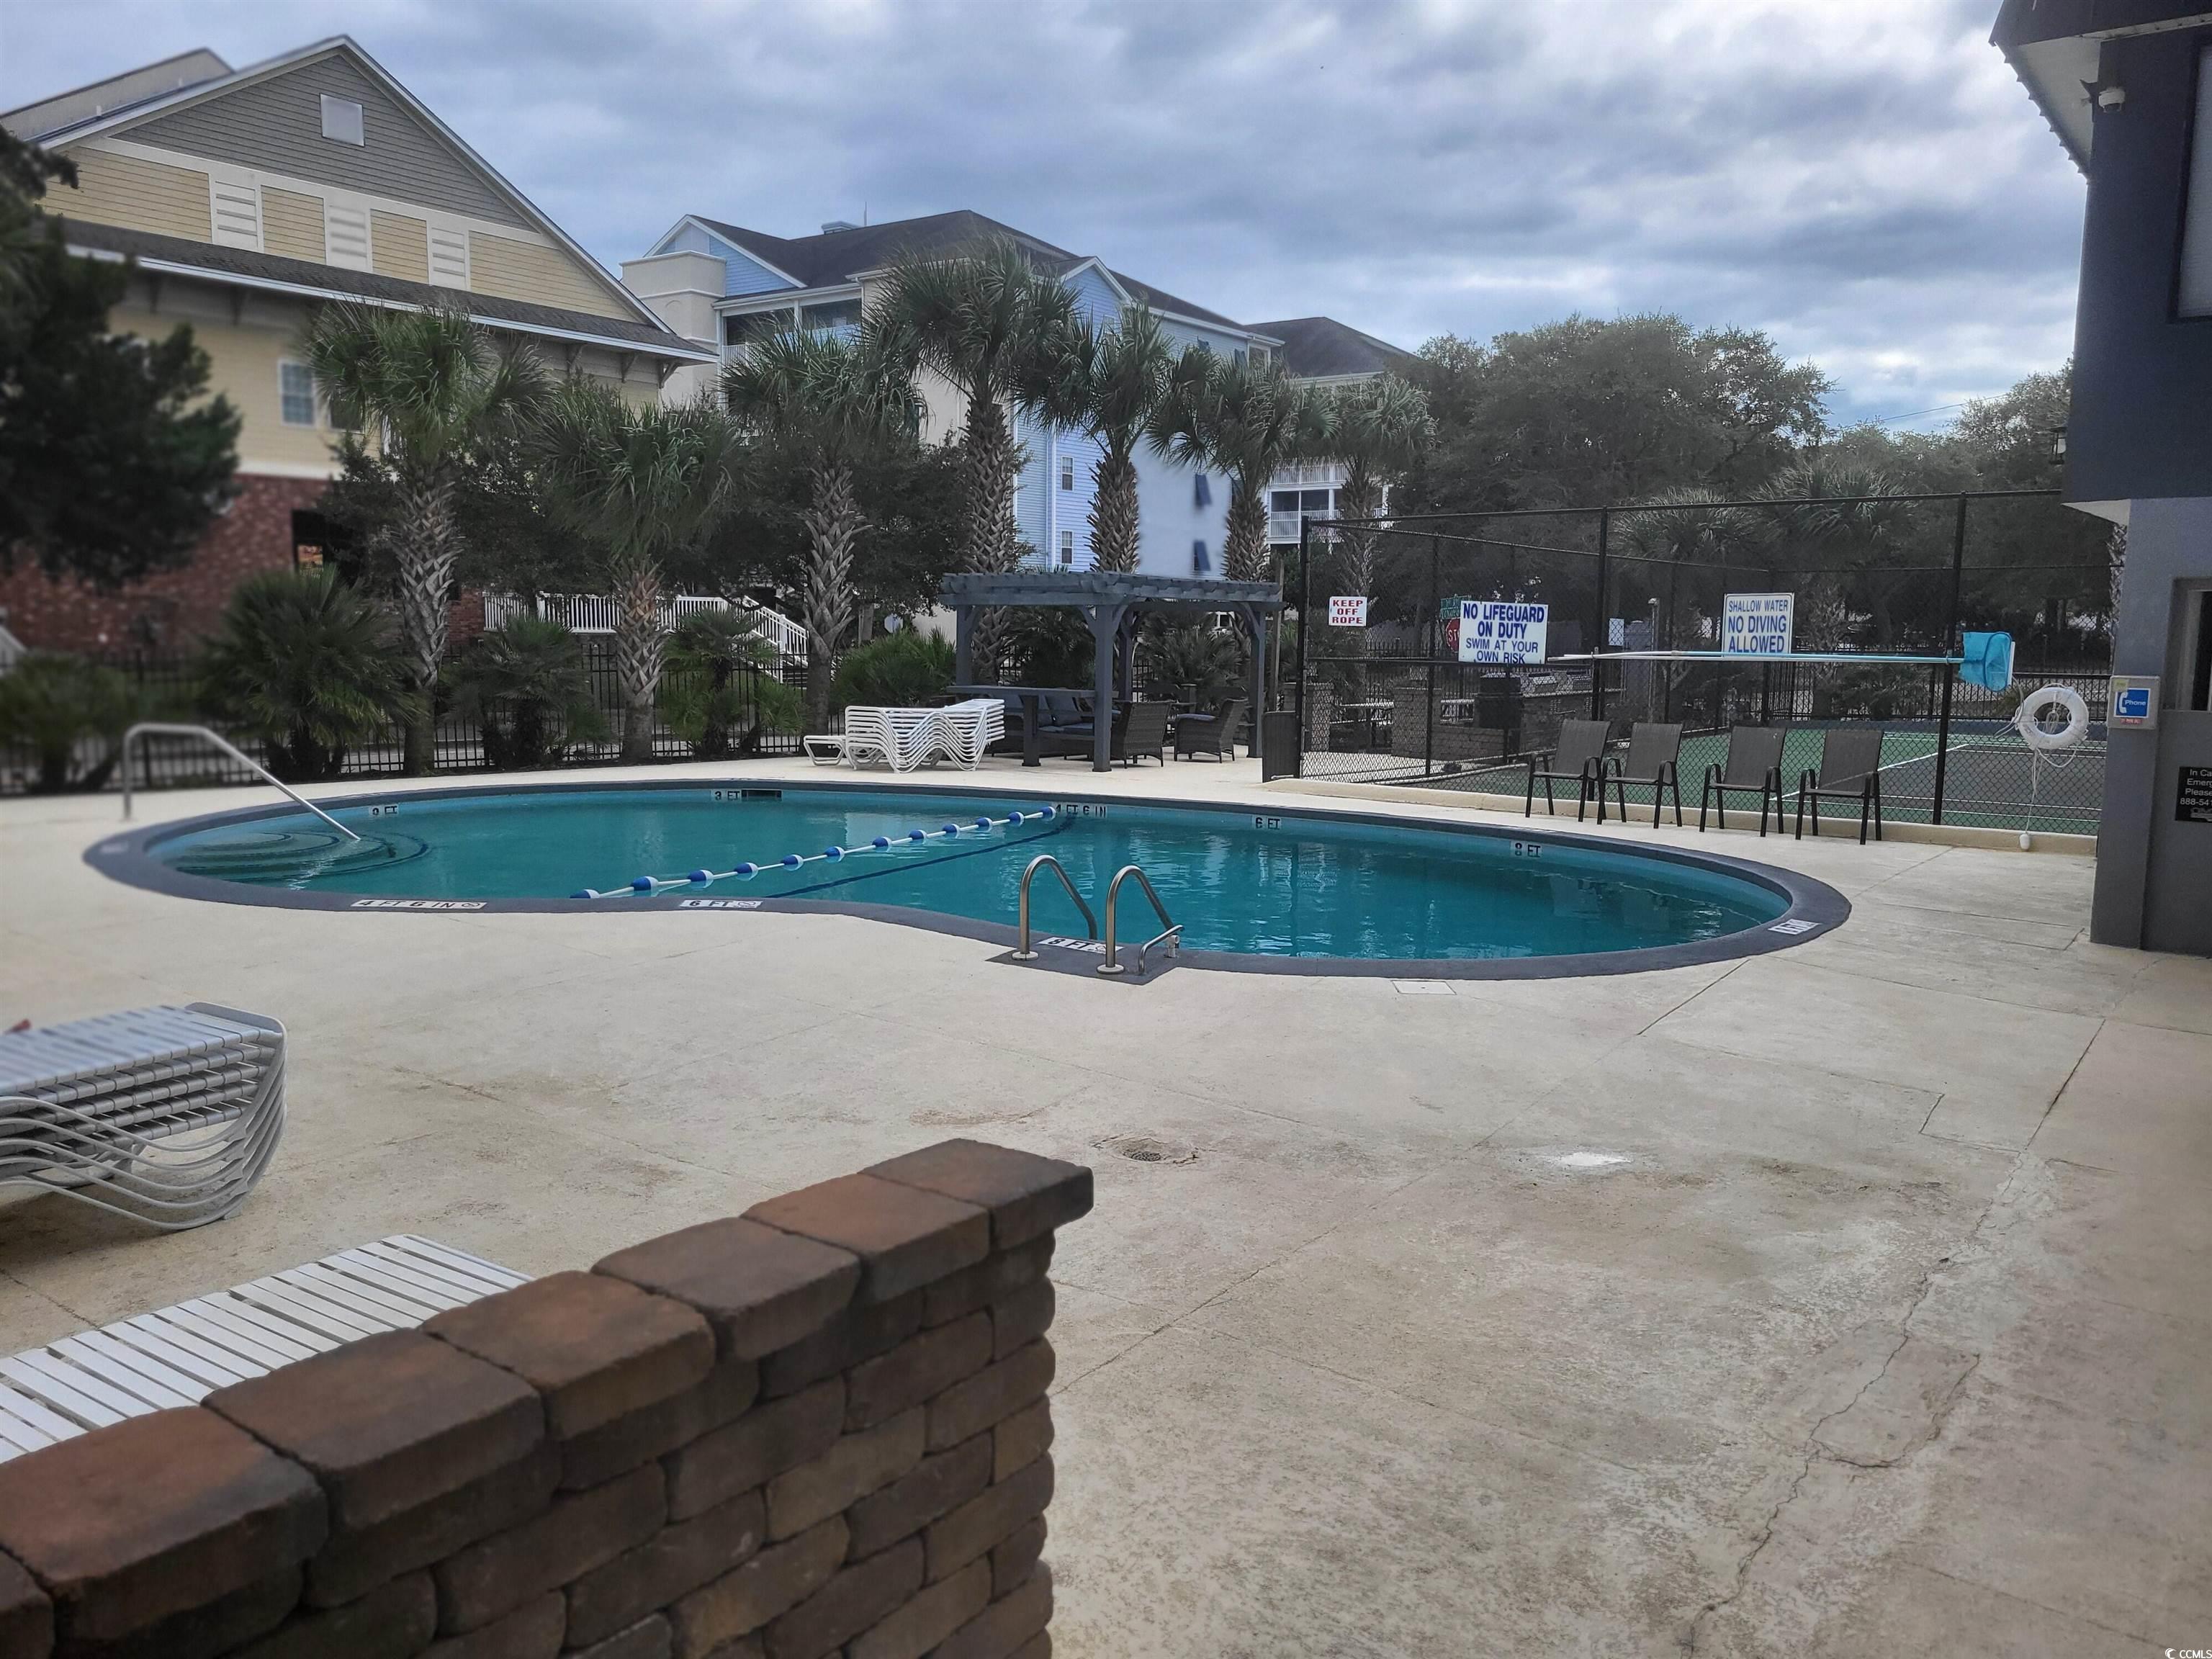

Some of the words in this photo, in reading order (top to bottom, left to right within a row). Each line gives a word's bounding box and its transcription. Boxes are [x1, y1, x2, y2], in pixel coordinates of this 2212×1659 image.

[1728, 600, 1762, 612] SHALLOW
[1764, 599, 1789, 612] WATER
[1463, 603, 1478, 619] NO
[1483, 604, 1545, 623] LIFEGUARD
[1478, 621, 1493, 637] ON
[1498, 622, 1527, 639] DUTY
[1728, 616, 1744, 634] NO
[1748, 615, 1786, 634] DIVING
[1466, 638, 1490, 649] SWIM
[1494, 640, 1506, 650] AT
[1511, 641, 1539, 653] YOUR
[1728, 635, 1784, 653] ALLOWED
[1477, 650, 1499, 662] OWN
[1503, 652, 1526, 664] RISK
[1095, 806, 1106, 818] IN
[1268, 818, 1280, 830] FT
[1527, 845, 1541, 858] FT
[1064, 940, 1095, 949] FT
